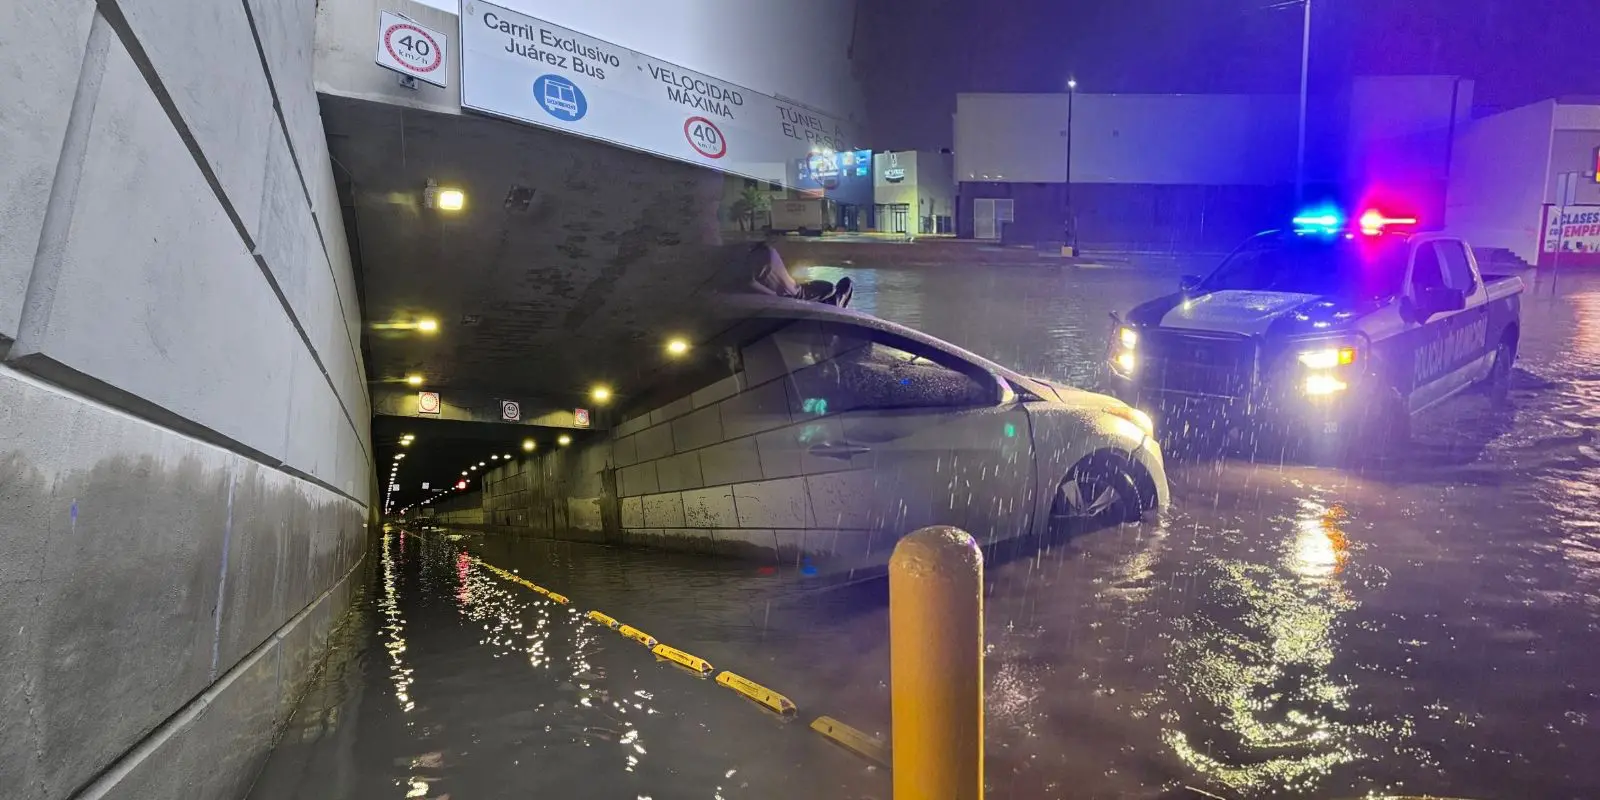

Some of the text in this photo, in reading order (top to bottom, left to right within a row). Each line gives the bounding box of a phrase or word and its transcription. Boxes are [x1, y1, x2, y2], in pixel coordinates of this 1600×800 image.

[398, 35, 430, 56] 40
[483, 12, 620, 67] Carril Exclusivo
[398, 49, 428, 65] km/h
[504, 38, 605, 80] Juárez Bus
[647, 63, 744, 106] VELOCIDAD
[667, 87, 734, 120] MÁXIMA
[776, 105, 828, 134] TÚNEL
[782, 122, 802, 140] EL
[693, 124, 717, 144] 40
[1561, 212, 1599, 225] CLASES
